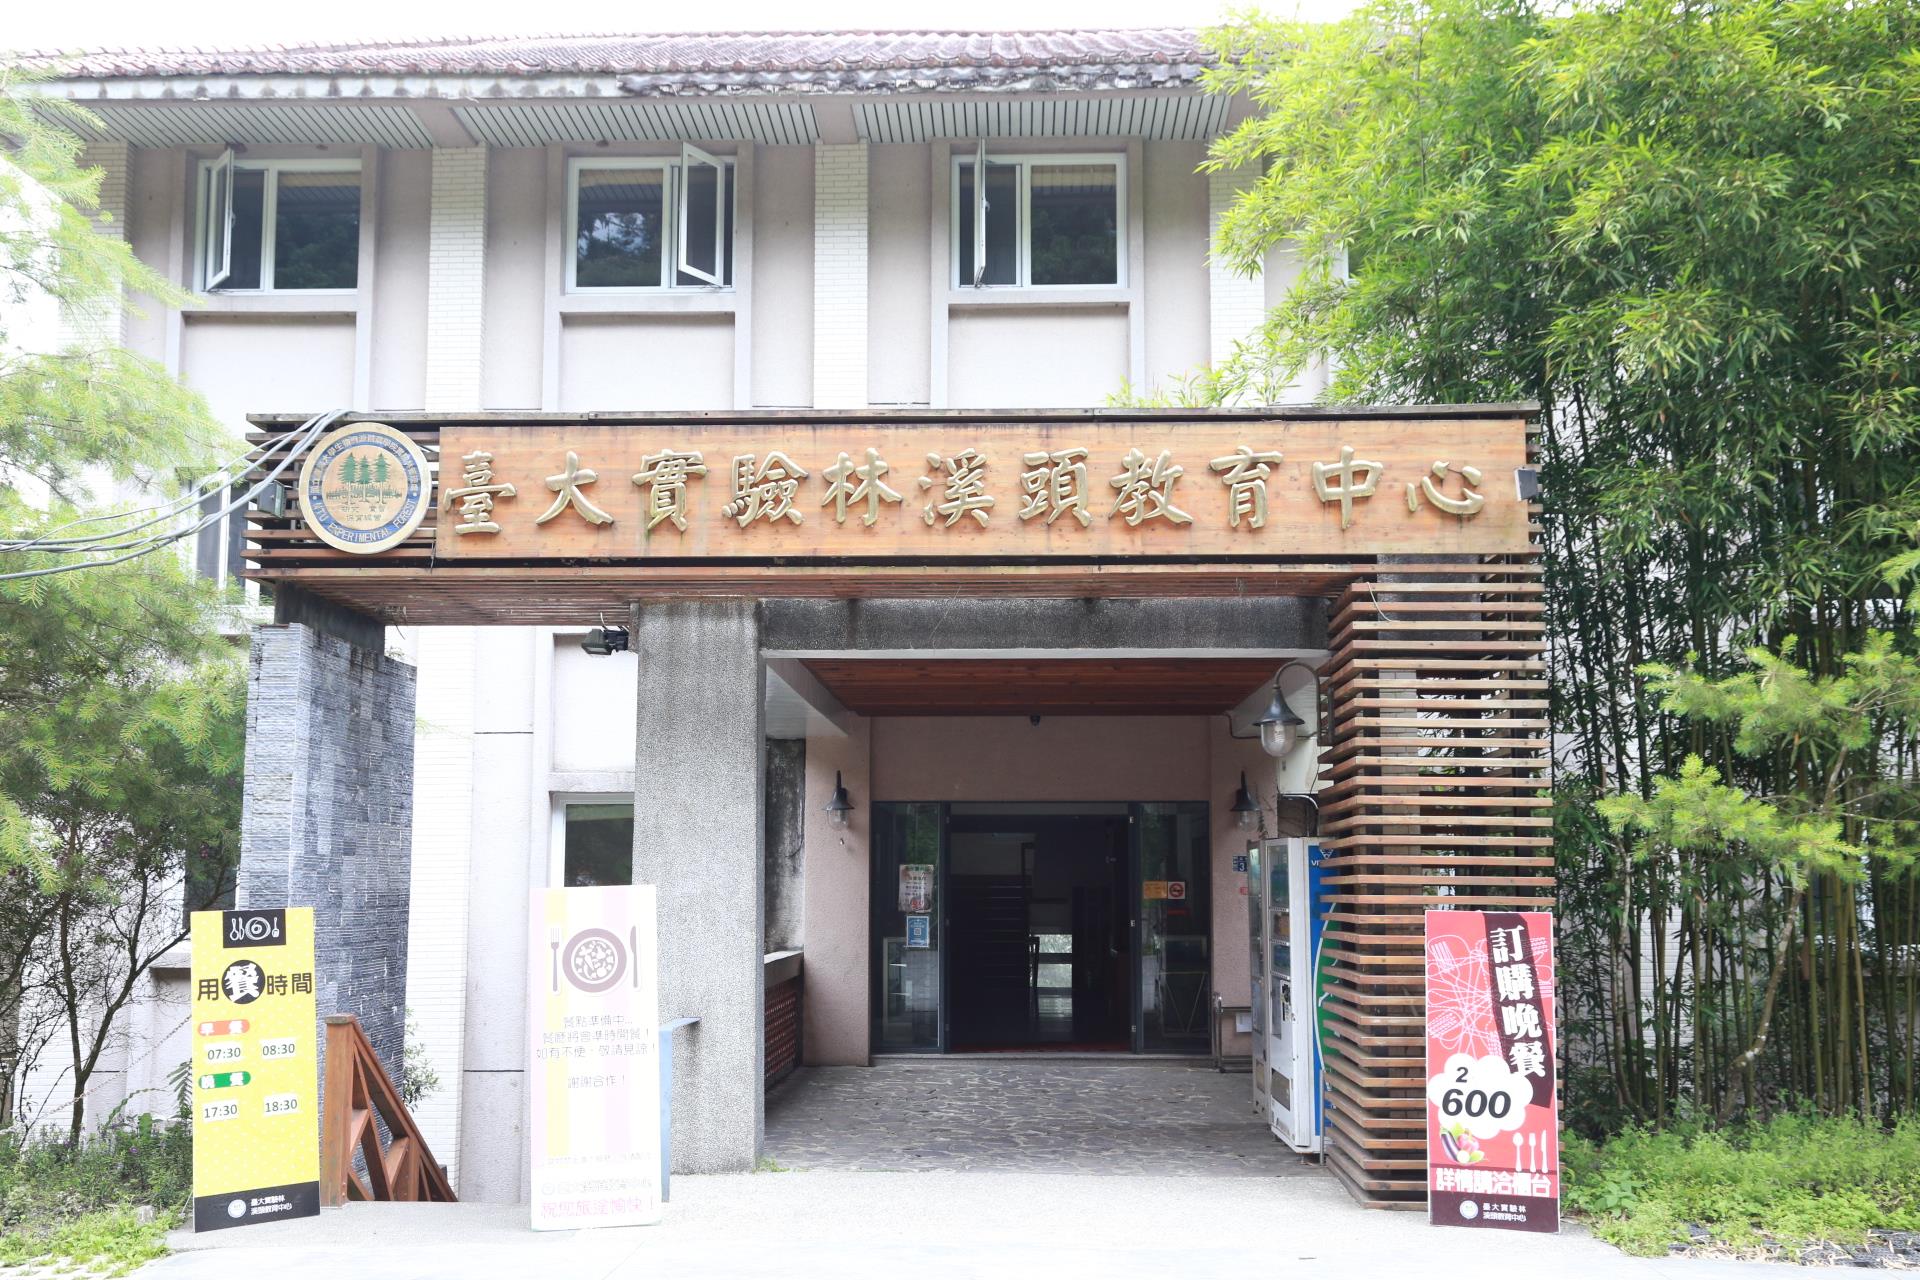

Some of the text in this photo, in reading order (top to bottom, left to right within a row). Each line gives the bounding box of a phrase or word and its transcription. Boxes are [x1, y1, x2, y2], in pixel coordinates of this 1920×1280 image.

[443, 446, 1484, 534] 臺大實驗林溪頭教育中心
[314, 498, 417, 543] NTU EXPERIMENTAL FOREST
[197, 963, 312, 1003] 用餐時間
[1489, 924, 1546, 1078] 訂購晚餐
[207, 1043, 295, 1060] 07:30 08:30
[1455, 1066, 1468, 1083] 2
[204, 1099, 298, 1119] 17:30 18:30
[1442, 1088, 1511, 1118] 600
